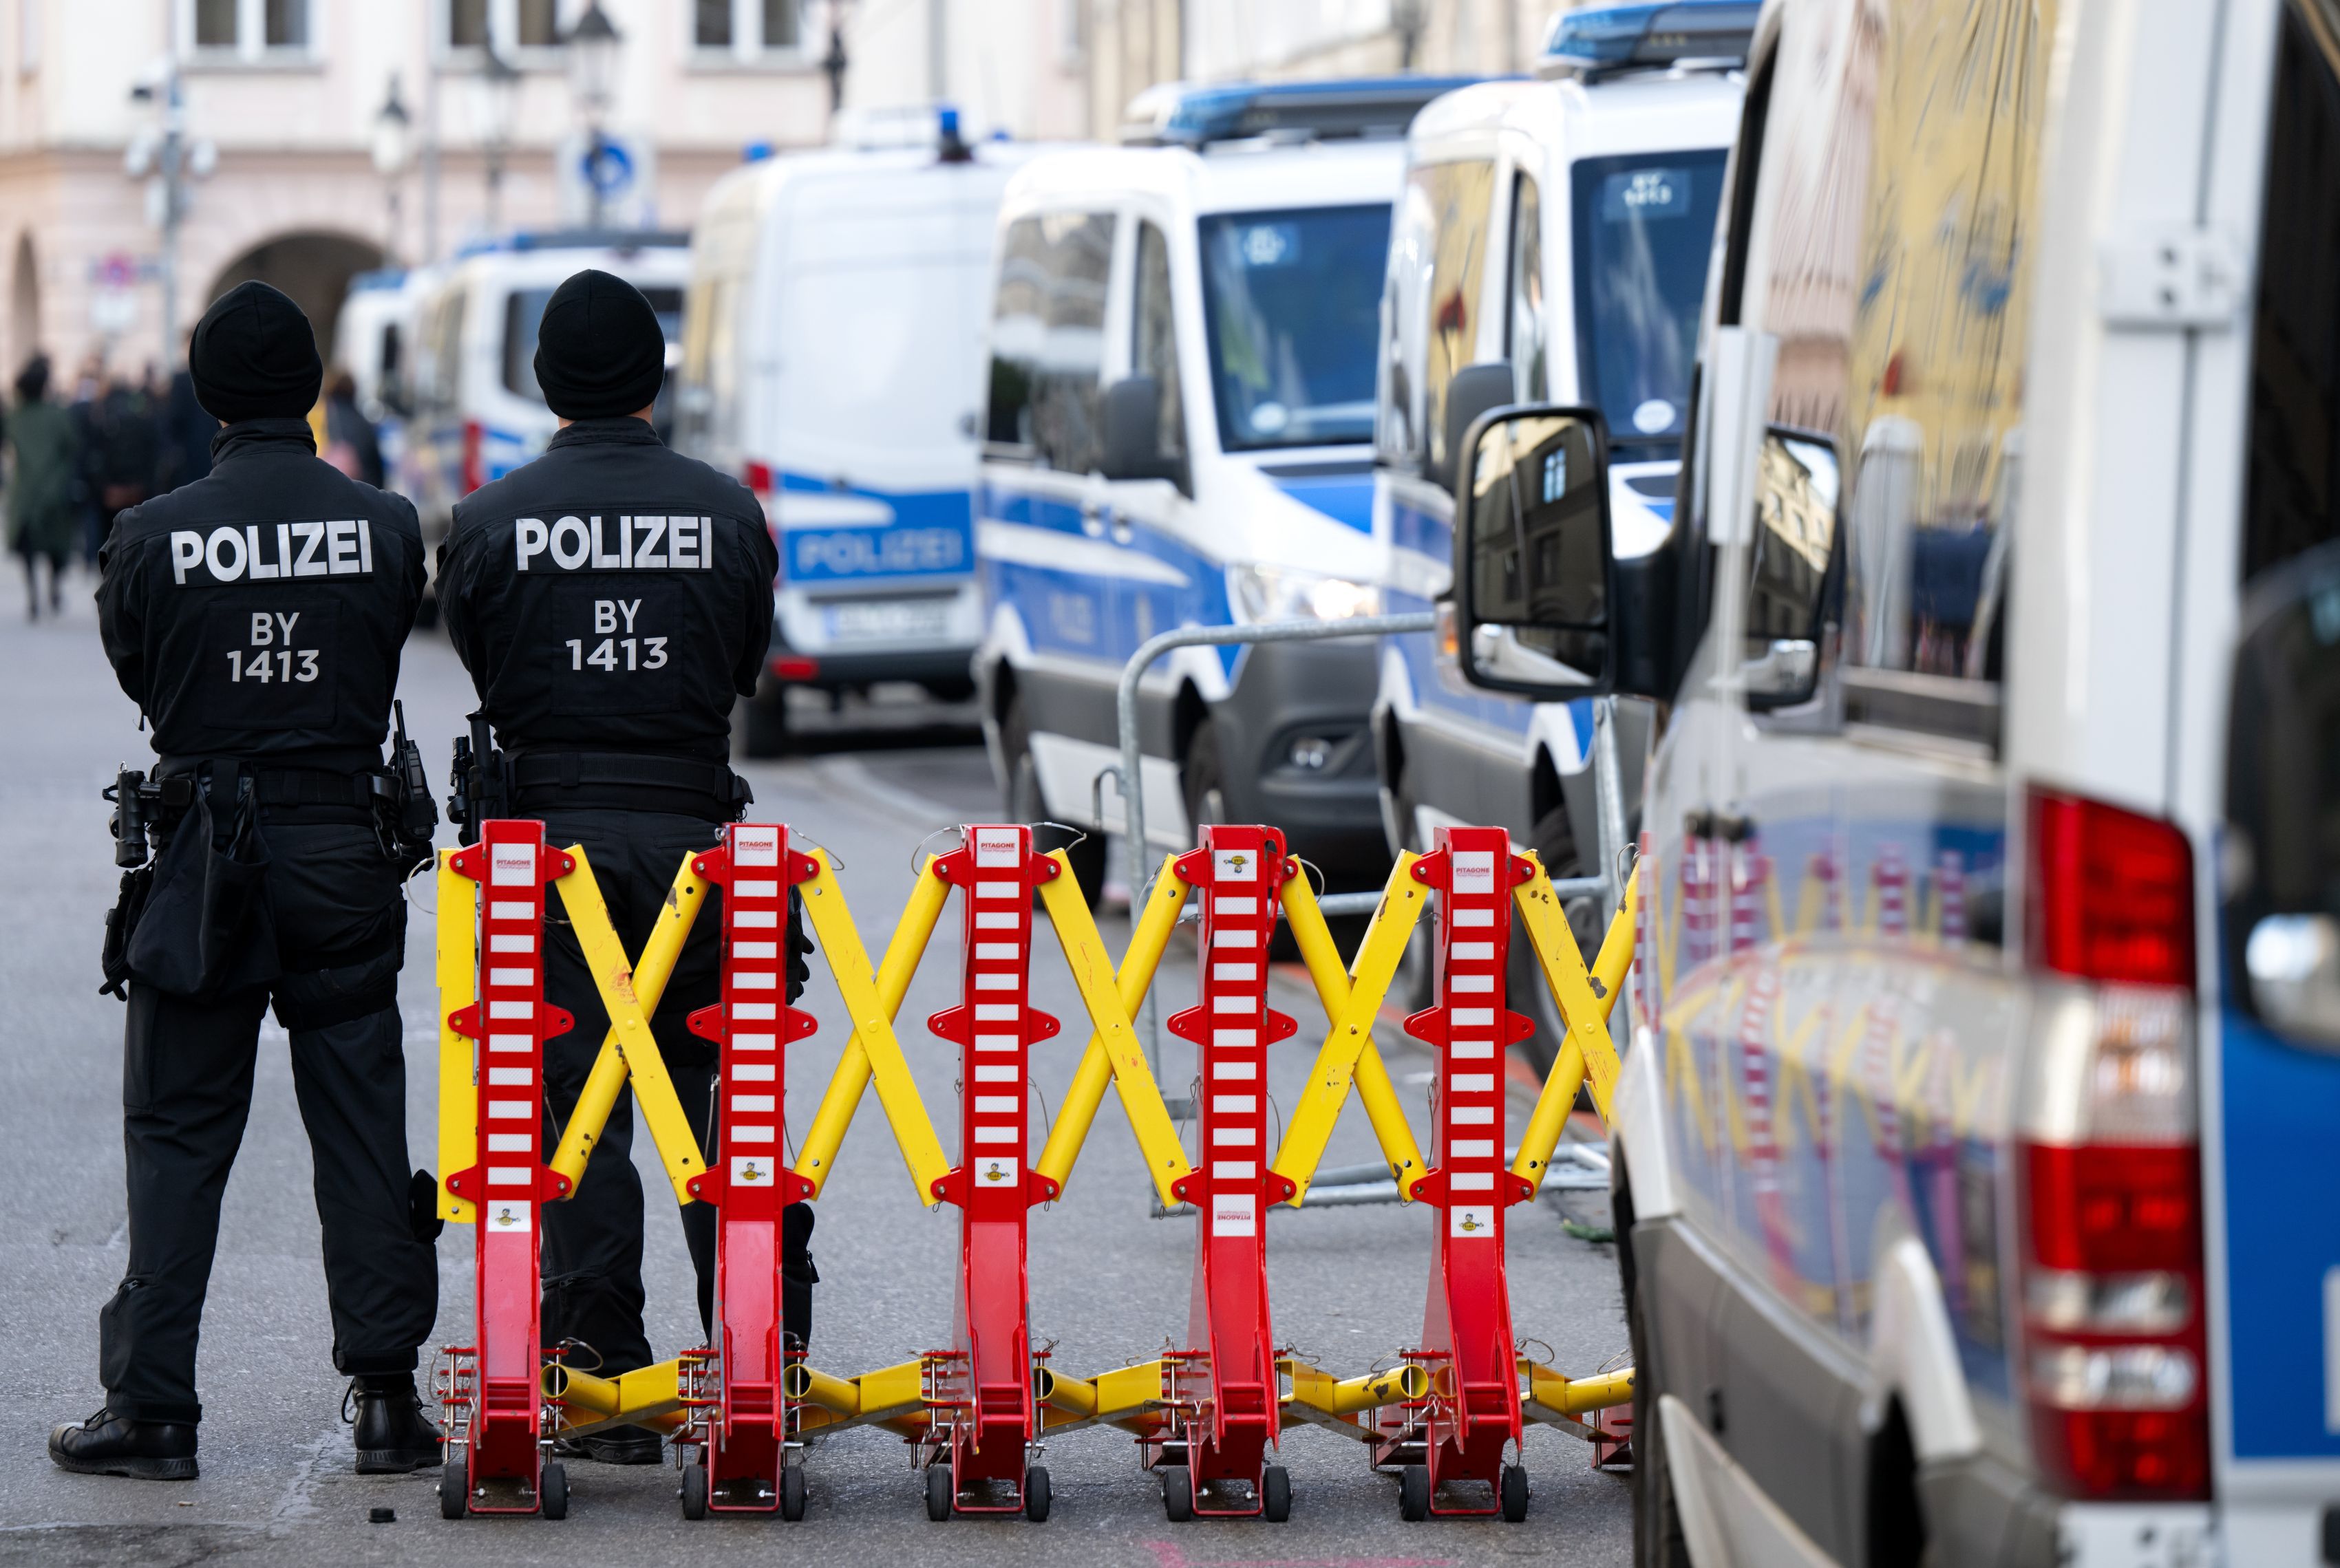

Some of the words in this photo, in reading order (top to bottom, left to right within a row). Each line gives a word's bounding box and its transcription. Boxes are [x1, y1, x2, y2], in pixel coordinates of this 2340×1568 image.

[171, 520, 372, 584] POLIZEI
[516, 516, 712, 570] POLIZEI
[796, 528, 962, 573] POLIZEI
[252, 613, 299, 645] BY
[595, 599, 641, 633] BY
[227, 650, 319, 683] 1413
[566, 637, 668, 671] 1413
